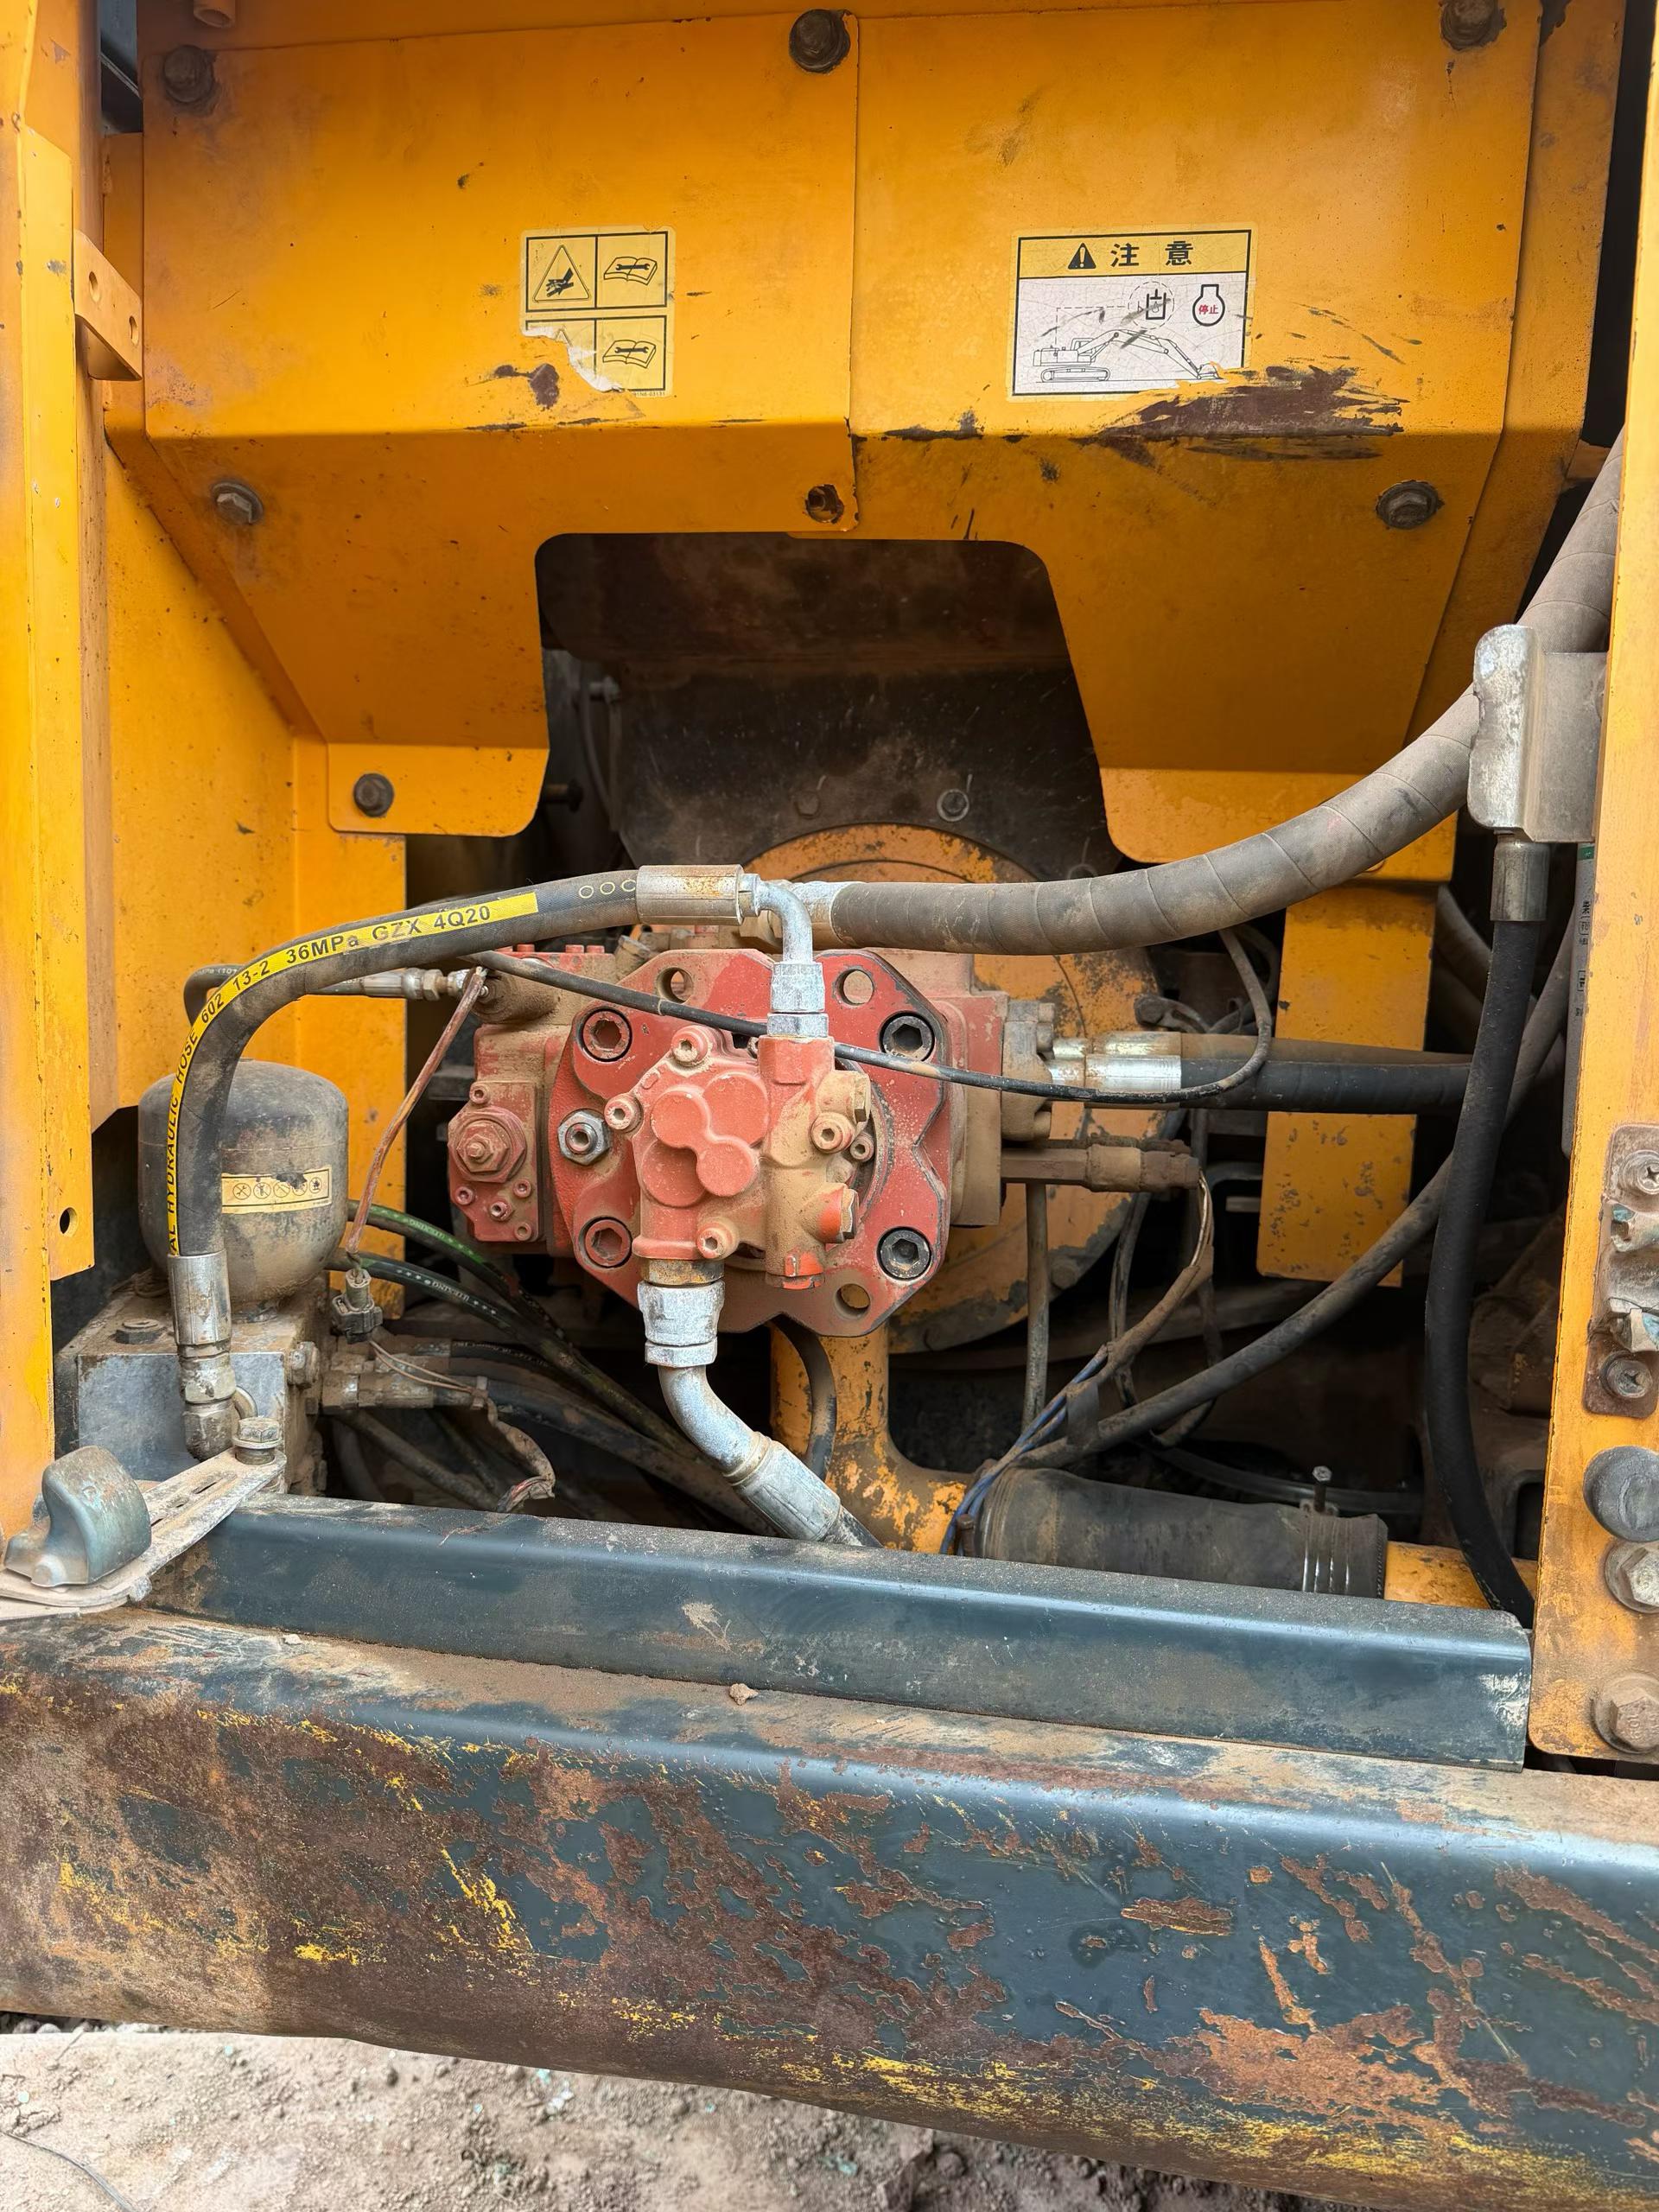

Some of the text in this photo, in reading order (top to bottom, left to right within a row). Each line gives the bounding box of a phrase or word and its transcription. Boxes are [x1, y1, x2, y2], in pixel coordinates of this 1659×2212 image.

[1109, 240, 1194, 268] 注意
[1198, 304, 1219, 316] 停止
[167, 1095, 180, 1214] HYDRAULIC
[175, 1027, 198, 1085] HOSE
[200, 994, 225, 1024] 602
[232, 960, 270, 991] 13-2
[286, 934, 359, 964] 36MPa
[372, 918, 423, 941] GZX
[434, 905, 491, 931] 4Q20
